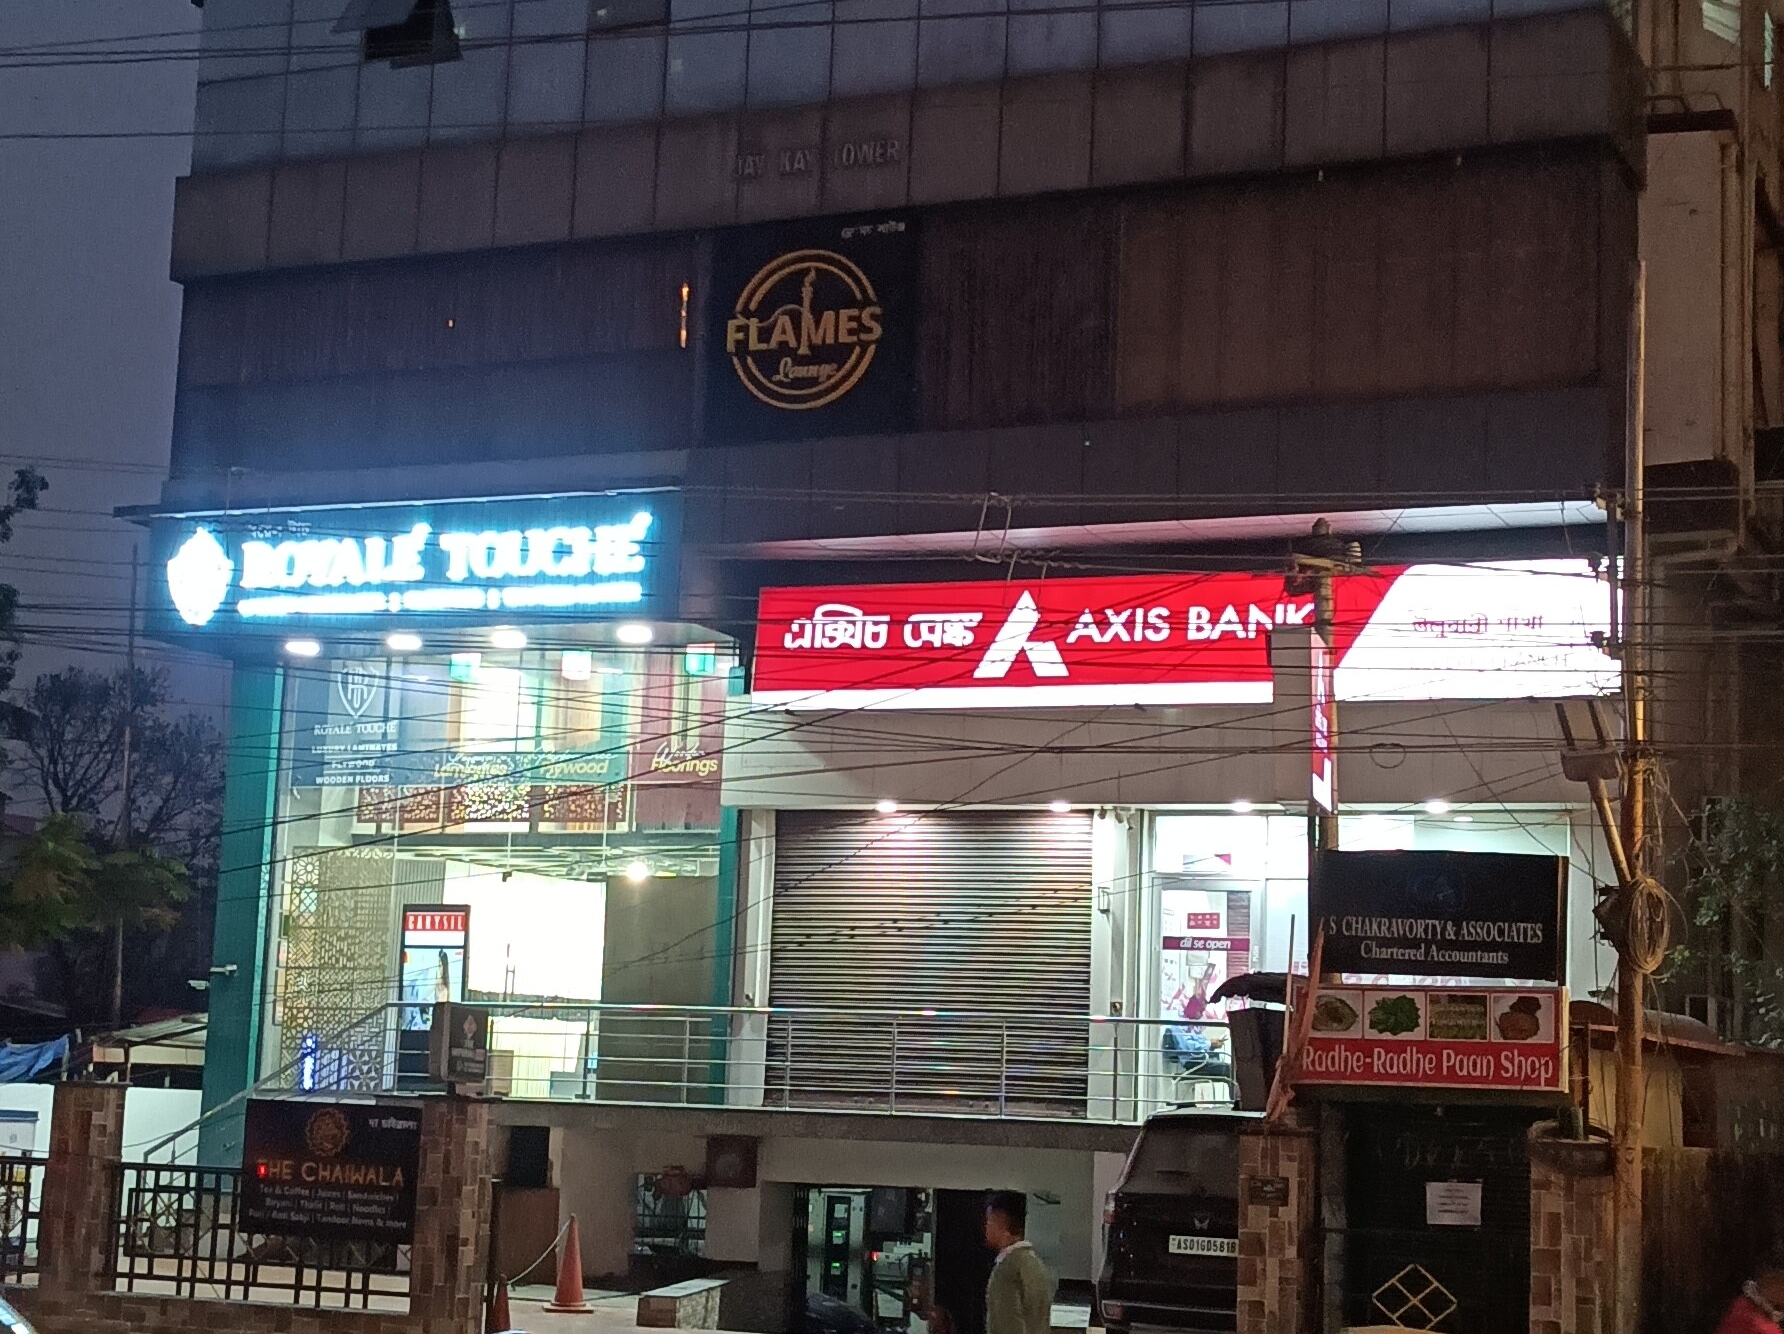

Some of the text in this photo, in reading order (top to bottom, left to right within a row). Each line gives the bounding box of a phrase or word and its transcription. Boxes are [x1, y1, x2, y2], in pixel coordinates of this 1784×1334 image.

[726, 306, 882, 354] FLAMES
[771, 357, 838, 382] Lounge
[1066, 603, 1315, 643] AXIS BANK
[316, 774, 390, 785] WOODEN FLOORS
[1180, 937, 1231, 950] dil se open
[1342, 916, 1445, 941] CHAKRAVORTY
[1446, 923, 1456, 940] &
[1458, 920, 1543, 944] ASSOCIATES
[1360, 940, 1510, 965] Chartered Accountants
[1302, 1043, 1553, 1087] Radhe-Radhe Paan Shop
[256, 1158, 405, 1187] THE CHAIWALA
